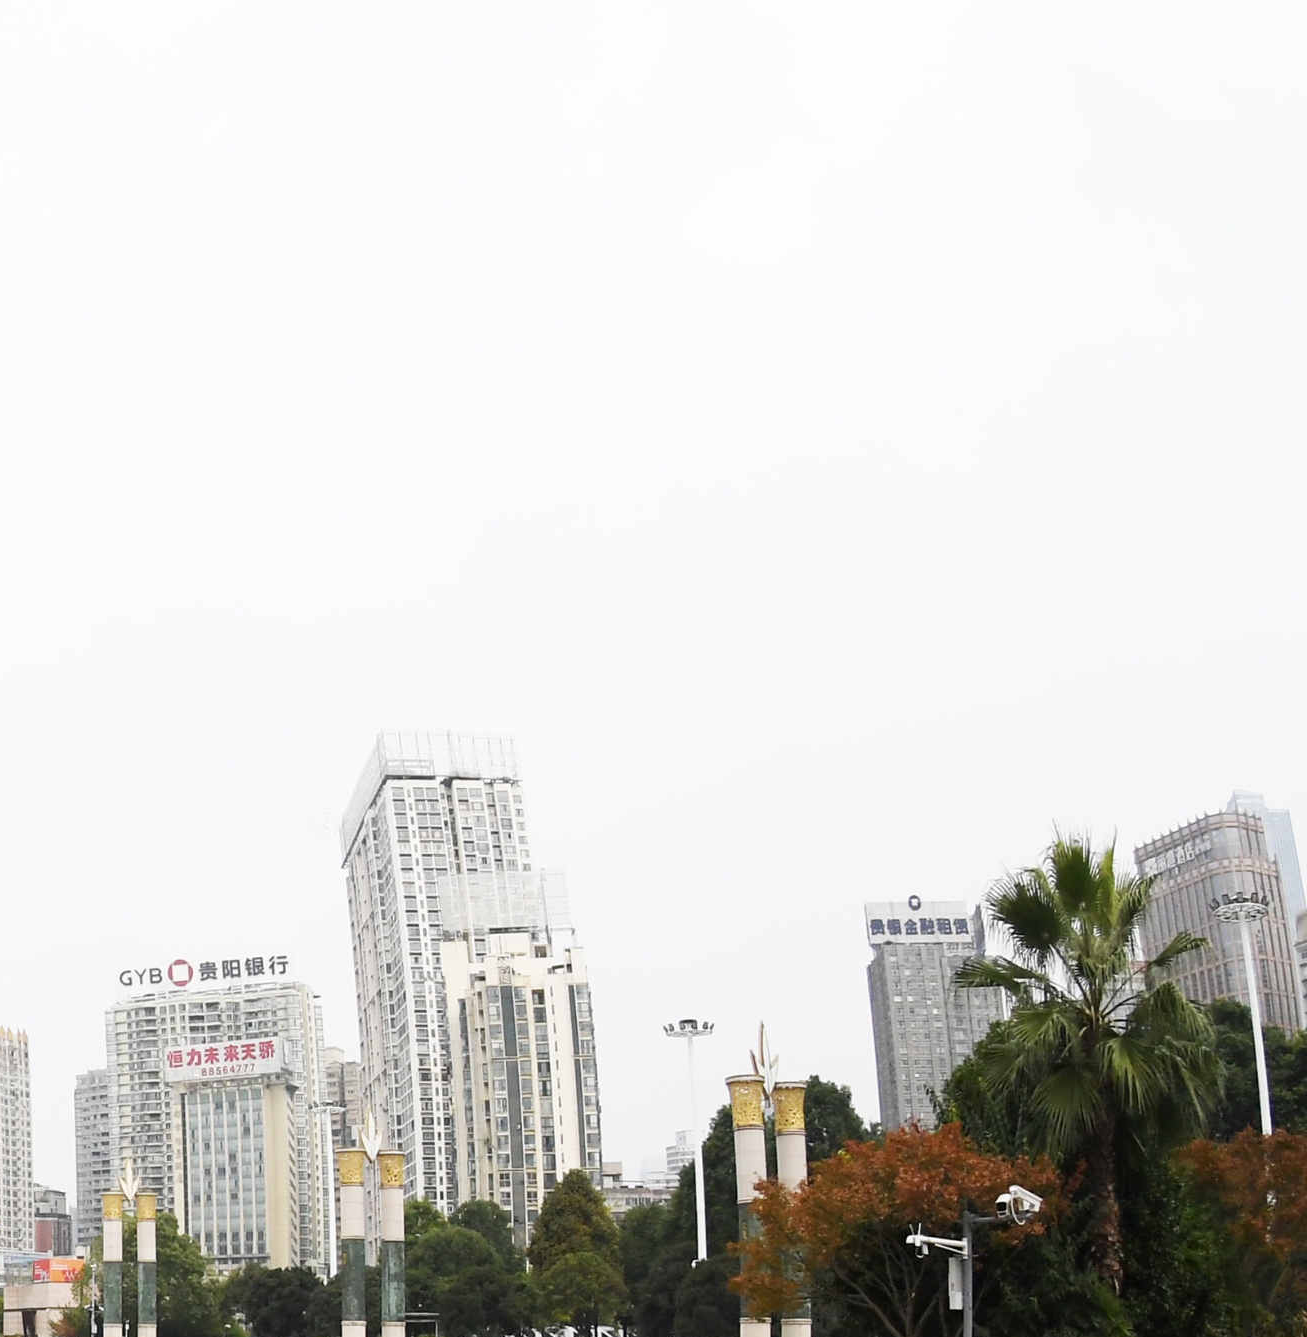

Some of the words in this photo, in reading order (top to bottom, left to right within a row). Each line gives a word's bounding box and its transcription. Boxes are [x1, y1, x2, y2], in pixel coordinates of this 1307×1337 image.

[119, 967, 163, 986] GYB
[198, 956, 289, 981] 贵阳银行
[167, 1041, 275, 1068] 恒力未来天骄
[201, 1063, 256, 1076] 88564777
